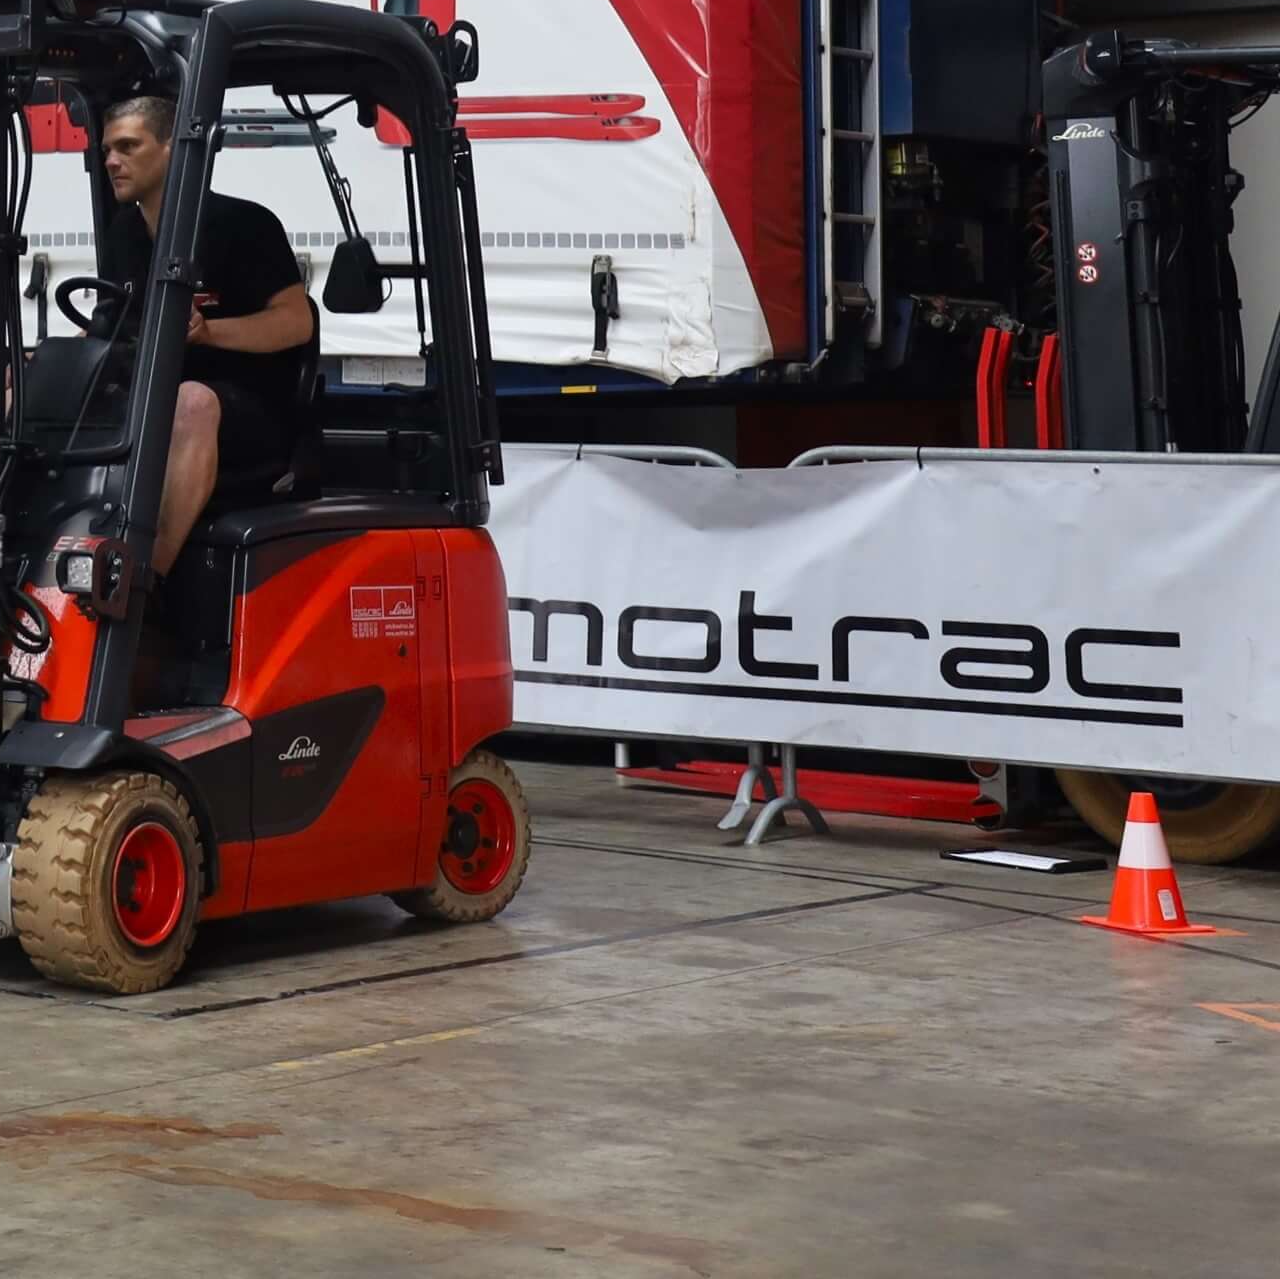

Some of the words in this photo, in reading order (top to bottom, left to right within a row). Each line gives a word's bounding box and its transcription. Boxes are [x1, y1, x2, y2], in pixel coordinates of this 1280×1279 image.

[1052, 123, 1105, 141] Linde
[507, 590, 1184, 704] motrac
[278, 735, 321, 761] Linde
